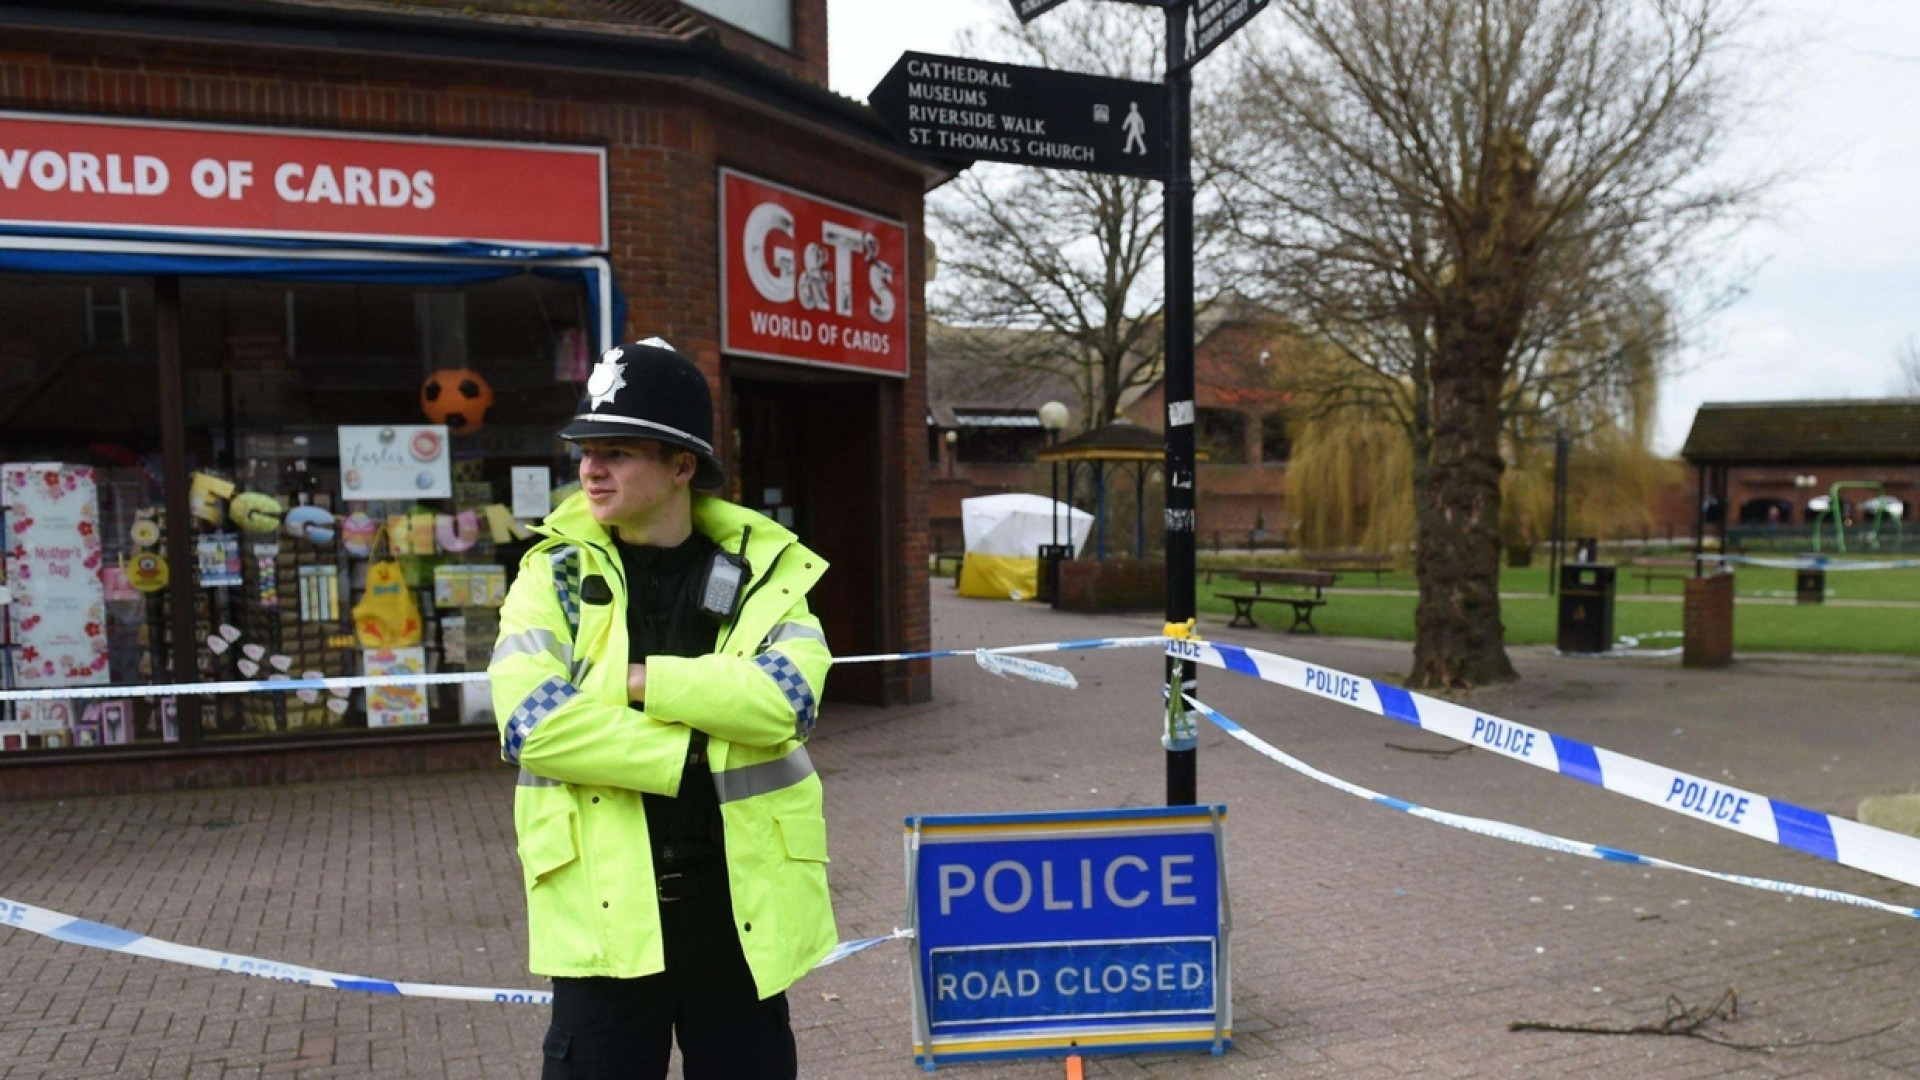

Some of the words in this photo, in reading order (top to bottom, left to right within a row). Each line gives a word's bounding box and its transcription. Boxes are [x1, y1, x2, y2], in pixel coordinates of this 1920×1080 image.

[907, 60, 1012, 88] CATHEDRAL
[908, 83, 987, 107] MUSEUMS
[908, 105, 996, 129] RIVERSIDE
[1001, 115, 1046, 135] WALK
[936, 130, 1021, 154] THOMAS'S
[1027, 140, 1095, 161] CHURCH
[190, 159, 253, 199] OF
[274, 163, 435, 208] CARDS
[750, 311, 812, 342] WORLD
[818, 323, 838, 345] OF
[842, 328, 890, 354] CARDS
[1305, 667, 1359, 701] POLICE
[1472, 717, 1534, 756] POLICE
[1667, 777, 1749, 825] POLICE
[938, 855, 1197, 915] POLICE
[937, 970, 1041, 1000] ROAD
[1055, 963, 1204, 995] CLOSED
